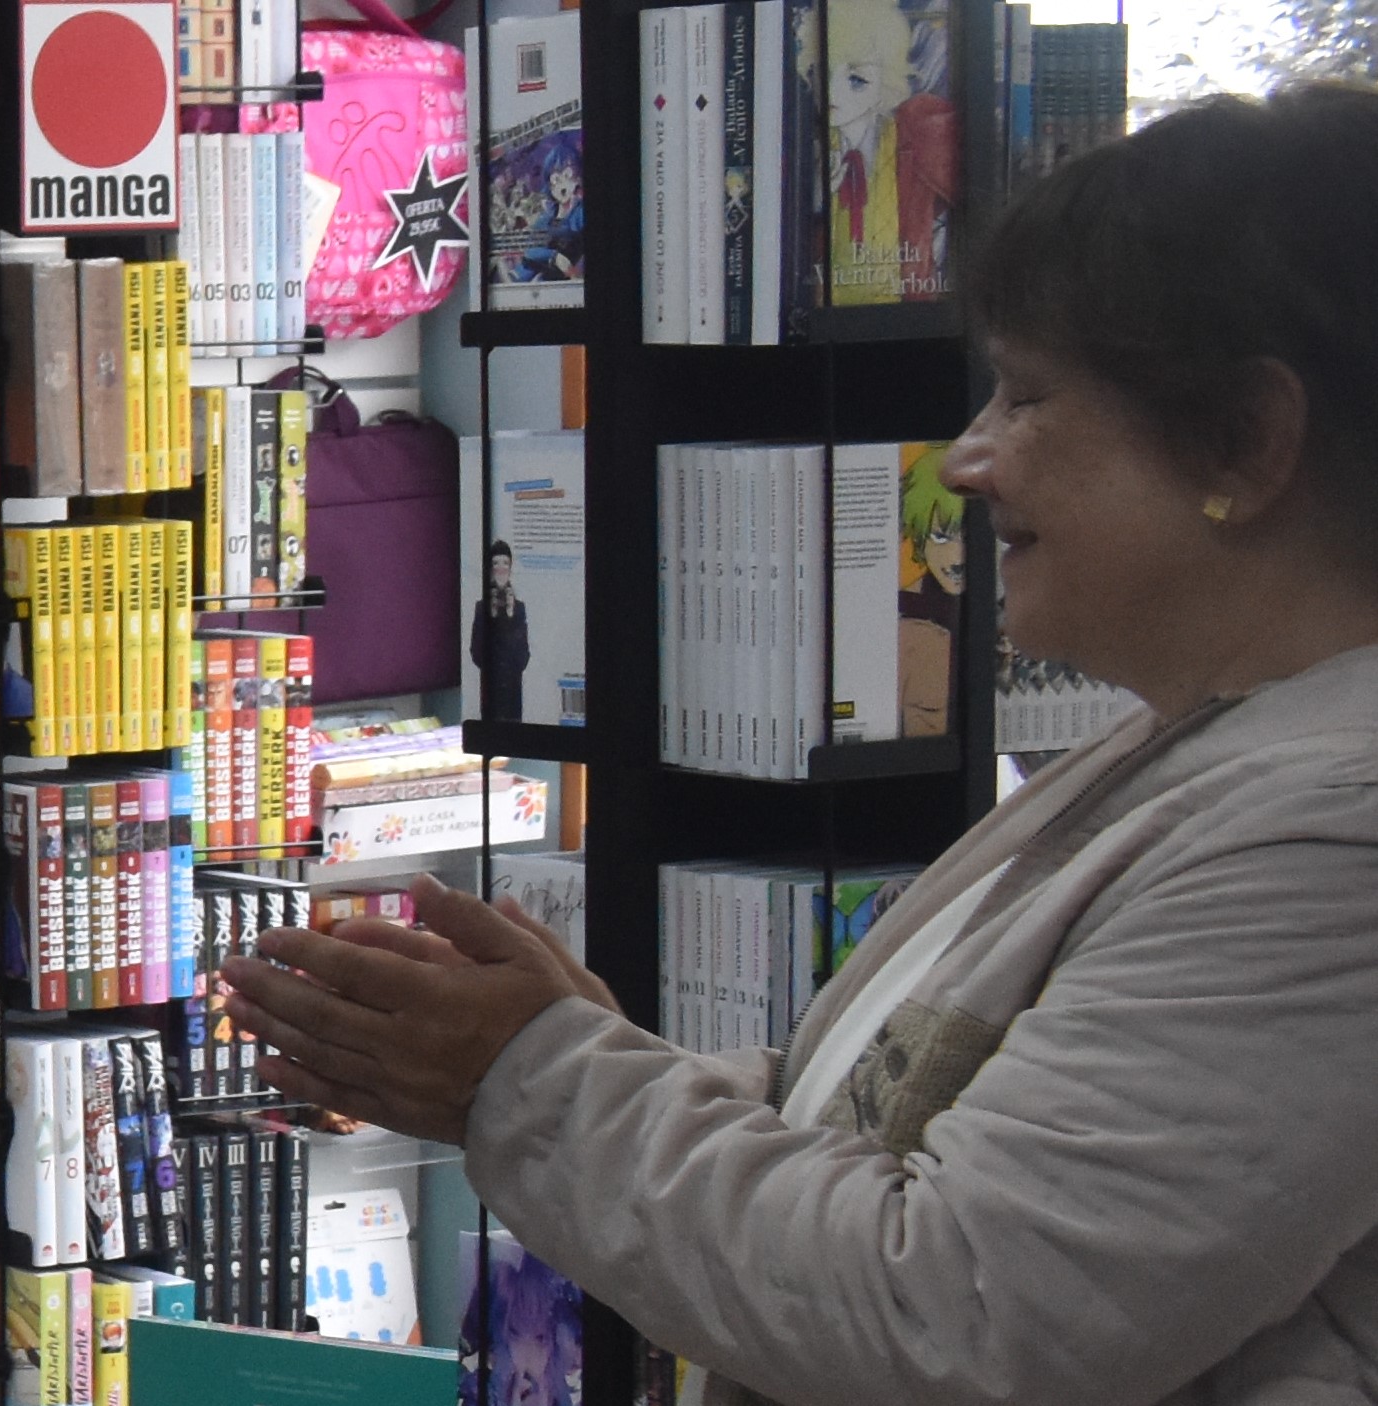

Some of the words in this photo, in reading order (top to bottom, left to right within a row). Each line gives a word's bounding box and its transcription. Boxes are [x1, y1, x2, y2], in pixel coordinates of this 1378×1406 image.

[29, 173, 170, 218] manga
[404, 198, 445, 217] OFERTA
[131, 271, 140, 296] FISH
[204, 282, 225, 300] 05
[230, 284, 250, 301] 03
[256, 282, 275, 300] 02
[284, 280, 302, 298] 01
[130, 298, 141, 351] BANANA
[37, 536, 48, 563] FISH
[59, 536, 70, 562] FISH
[103, 533, 114, 559] FISH
[151, 531, 162, 557] FISH
[177, 529, 187, 555] FISH
[37, 567, 49, 616] BANANA
[60, 567, 71, 615] BANANA
[103, 564, 115, 611] BANANA
[151, 561, 162, 609] BANANA
[177, 560, 187, 607] BANANA
[270, 725, 285, 818] BERSERK
[295, 725, 310, 817] BERSERK
[48, 878, 65, 970] BERSERK
[74, 876, 90, 970] BERSERK
[101, 875, 116, 969] BERSERK
[127, 872, 142, 967] BERSERK
[187, 1015, 206, 1047] 5
[214, 1014, 233, 1046] 4
[198, 1145, 218, 1168] IV
[227, 1143, 246, 1166] III
[260, 1140, 275, 1163] II
[293, 1139, 301, 1161] I
[40, 1159, 51, 1181] 7
[66, 1157, 79, 1180] 8
[127, 1159, 146, 1191] 7
[155, 1159, 176, 1190] 6
